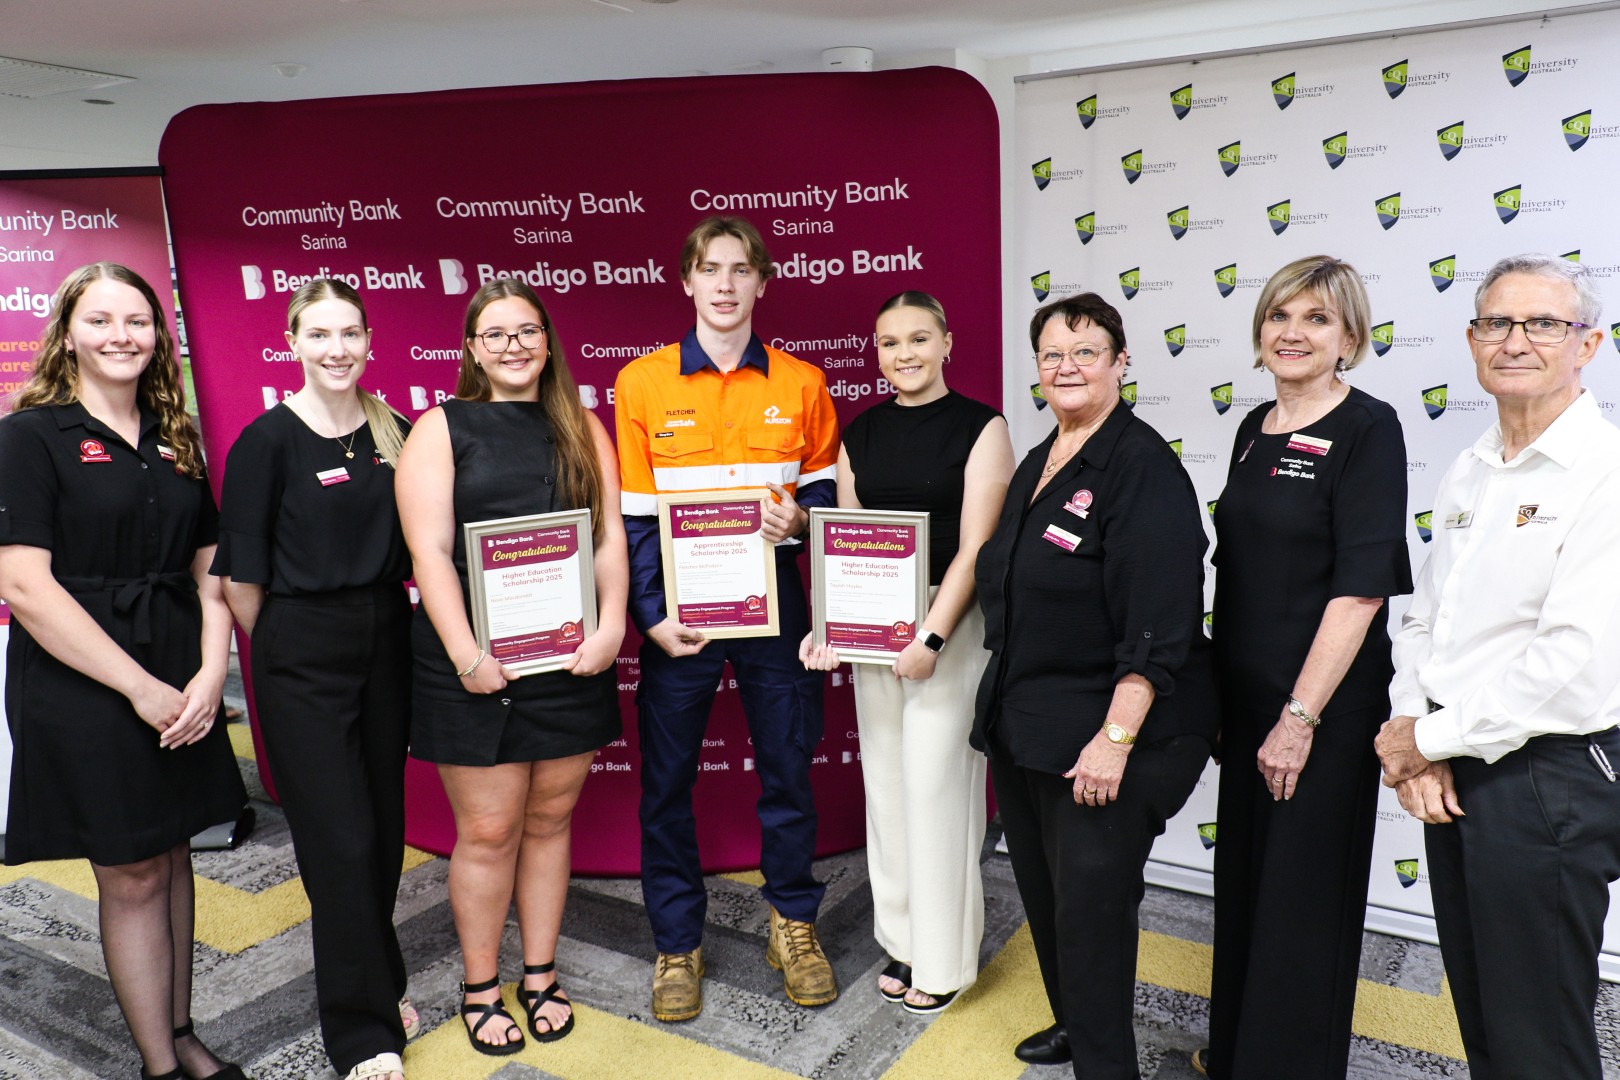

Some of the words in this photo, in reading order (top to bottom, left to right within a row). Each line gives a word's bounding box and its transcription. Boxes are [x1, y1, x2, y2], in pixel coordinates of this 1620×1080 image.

[690, 184, 837, 212] Community
[845, 177, 909, 204] Bank
[242, 201, 344, 228] Community
[349, 198, 402, 221] Bank
[436, 193, 572, 222] Community
[579, 190, 646, 215] Bank
[0, 210, 54, 236] unity
[61, 208, 119, 230] Bank
[772, 218, 834, 236] Sarina
[301, 233, 347, 250] Sarina
[513, 227, 573, 244] Sarina
[0, 246, 54, 262] Sarina
[593, 259, 666, 285] Bank
[771, 253, 845, 285] ndigo
[852, 245, 923, 274] Bank
[364, 264, 426, 290] Bank
[581, 342, 664, 358] Communi
[771, 334, 868, 352] Community
[824, 356, 864, 368] Sarina
[828, 380, 872, 401] digo
[1277, 469, 1300, 477] Bendigo
[681, 519, 752, 532] Congratulations
[493, 544, 568, 562] Congratulations
[694, 541, 743, 549] Apprenticeship
[834, 538, 905, 551] Congratulations
[502, 572, 525, 580] Higher
[528, 566, 562, 576] Education
[503, 577, 544, 588] Scholarship
[606, 762, 631, 771] Bank
[703, 761, 729, 770] Bank
[812, 755, 828, 764] ank
